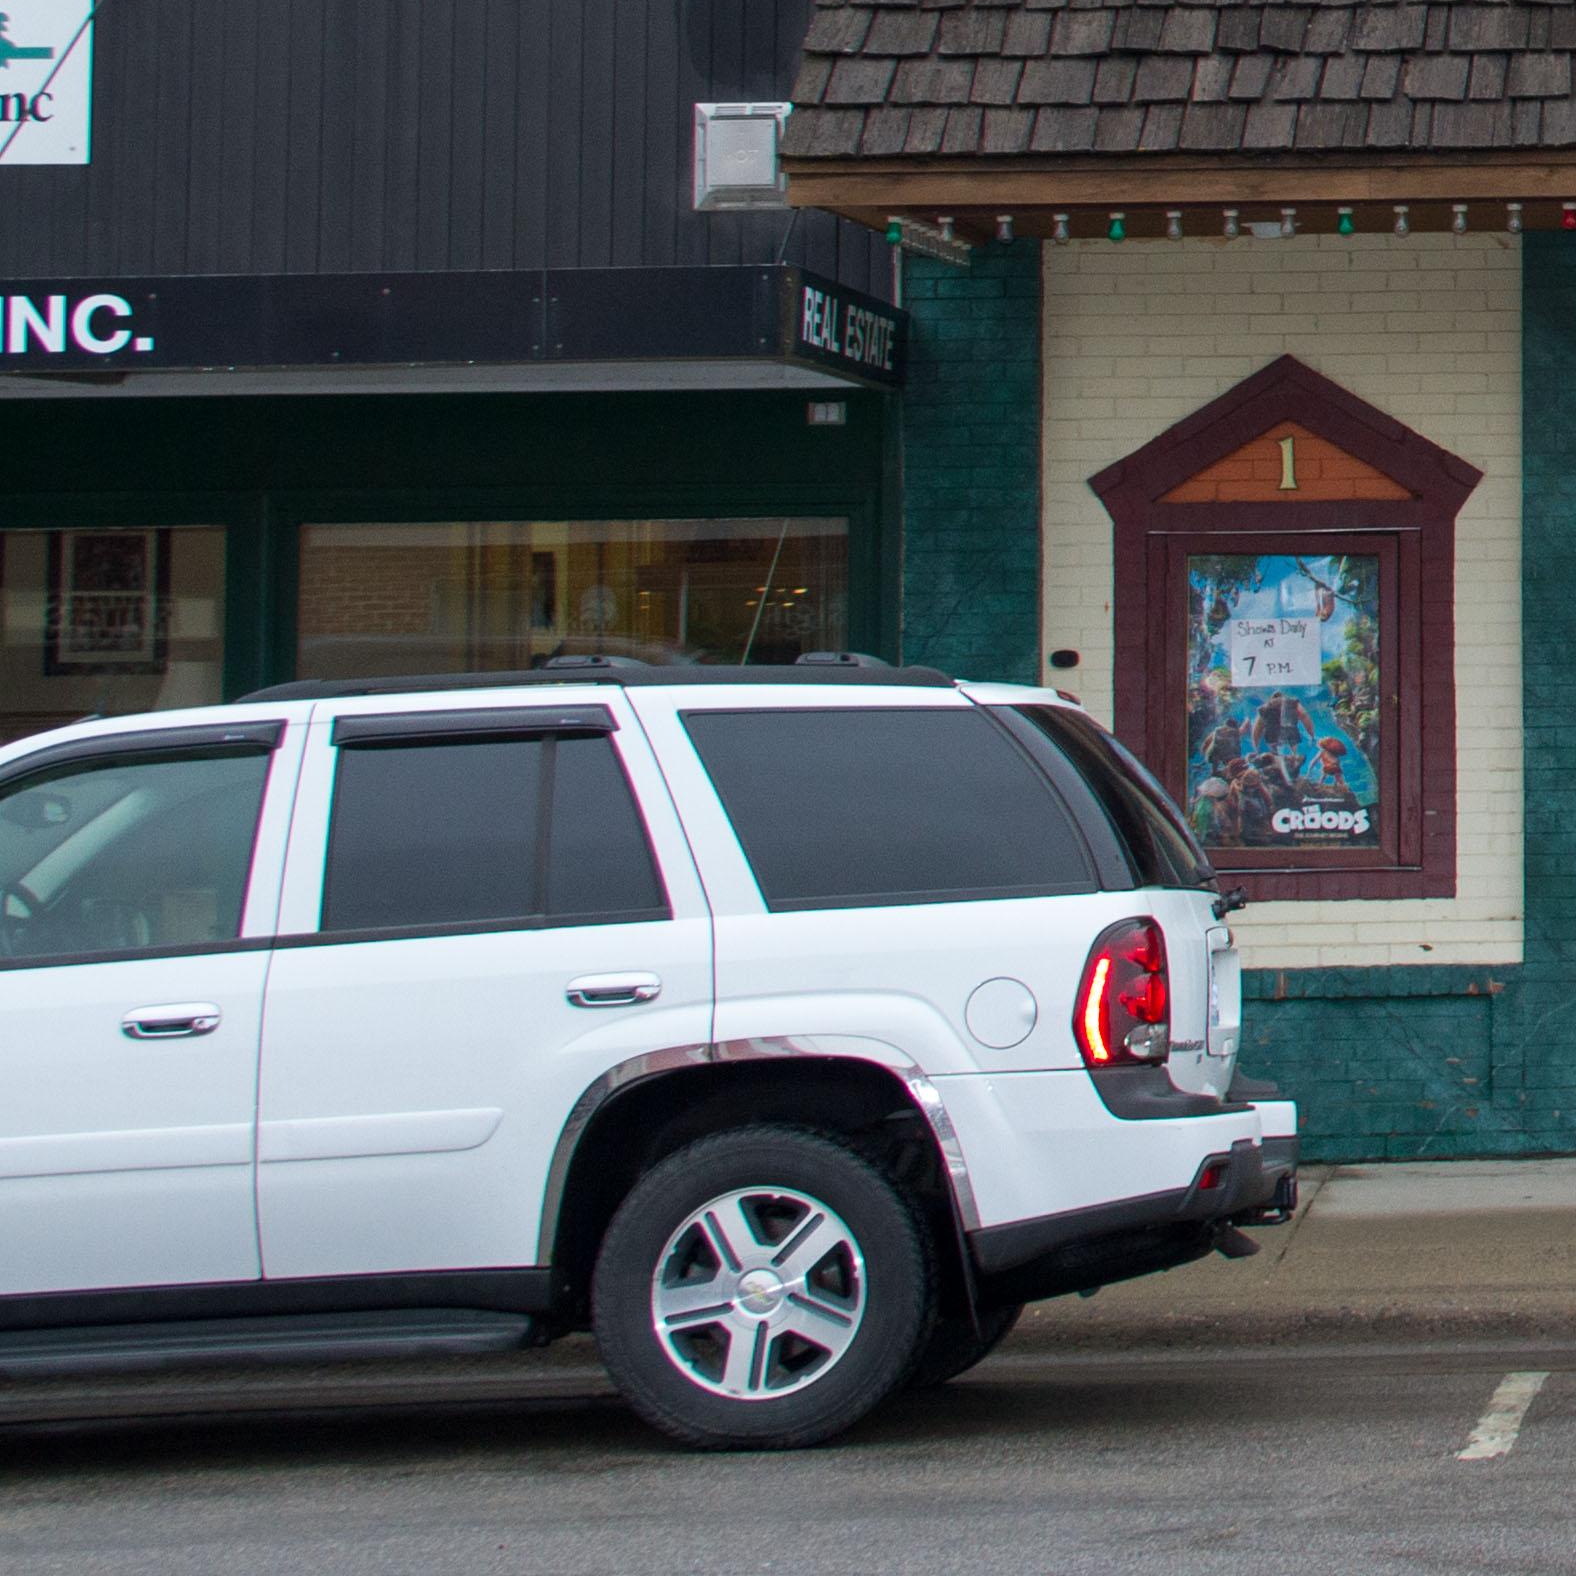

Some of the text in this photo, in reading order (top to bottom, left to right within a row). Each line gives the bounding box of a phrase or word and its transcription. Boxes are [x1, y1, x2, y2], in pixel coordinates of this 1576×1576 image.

[0, 294, 154, 354] NC.
[801, 285, 897, 372] REAL ESTATE
[1277, 435, 1299, 492] 1
[1237, 620, 1277, 637] Shows
[1242, 655, 1256, 677] 7
[1272, 808, 1370, 835] CROODS
